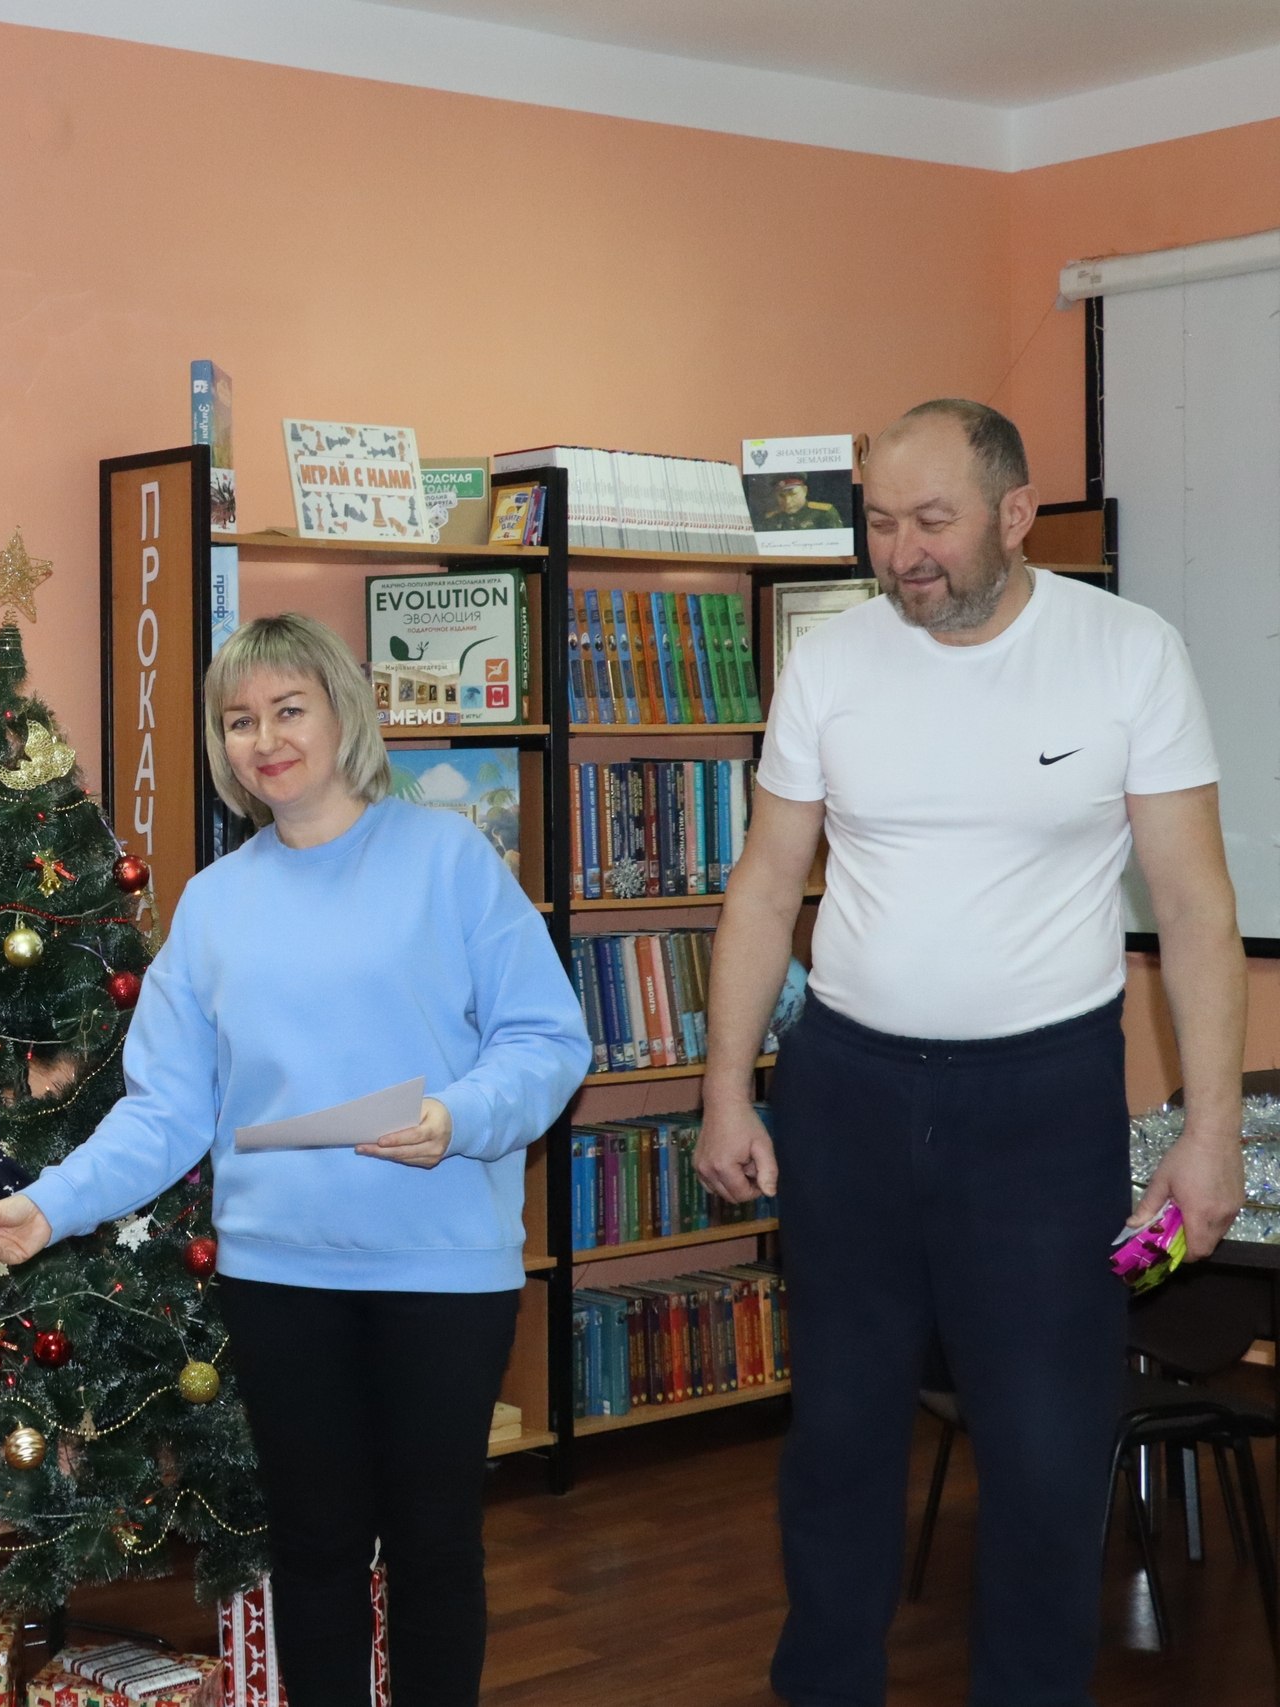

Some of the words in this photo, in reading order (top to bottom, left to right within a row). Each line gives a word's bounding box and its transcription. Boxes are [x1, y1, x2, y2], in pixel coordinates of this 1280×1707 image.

[775, 447, 842, 457] ЗНАМЕНИТЫЕ
[796, 455, 842, 464] ЗЕМЛЯКИ
[300, 461, 350, 486] ИГРАЙ
[354, 467, 363, 487] С
[367, 467, 412, 489] НАМИ
[381, 581, 446, 589] НАУЧНО-ПОПУЛЯРНАЯ
[376, 586, 508, 611] EVOLUTION
[403, 610, 482, 625] ЭВОЛЮЦИЯ
[407, 626, 449, 634] ПОДАРОЧНОЕ
[678, 810, 686, 875] КОСМОНАВТИКА
[646, 976, 656, 1014] ЧЕЛОВЕК
